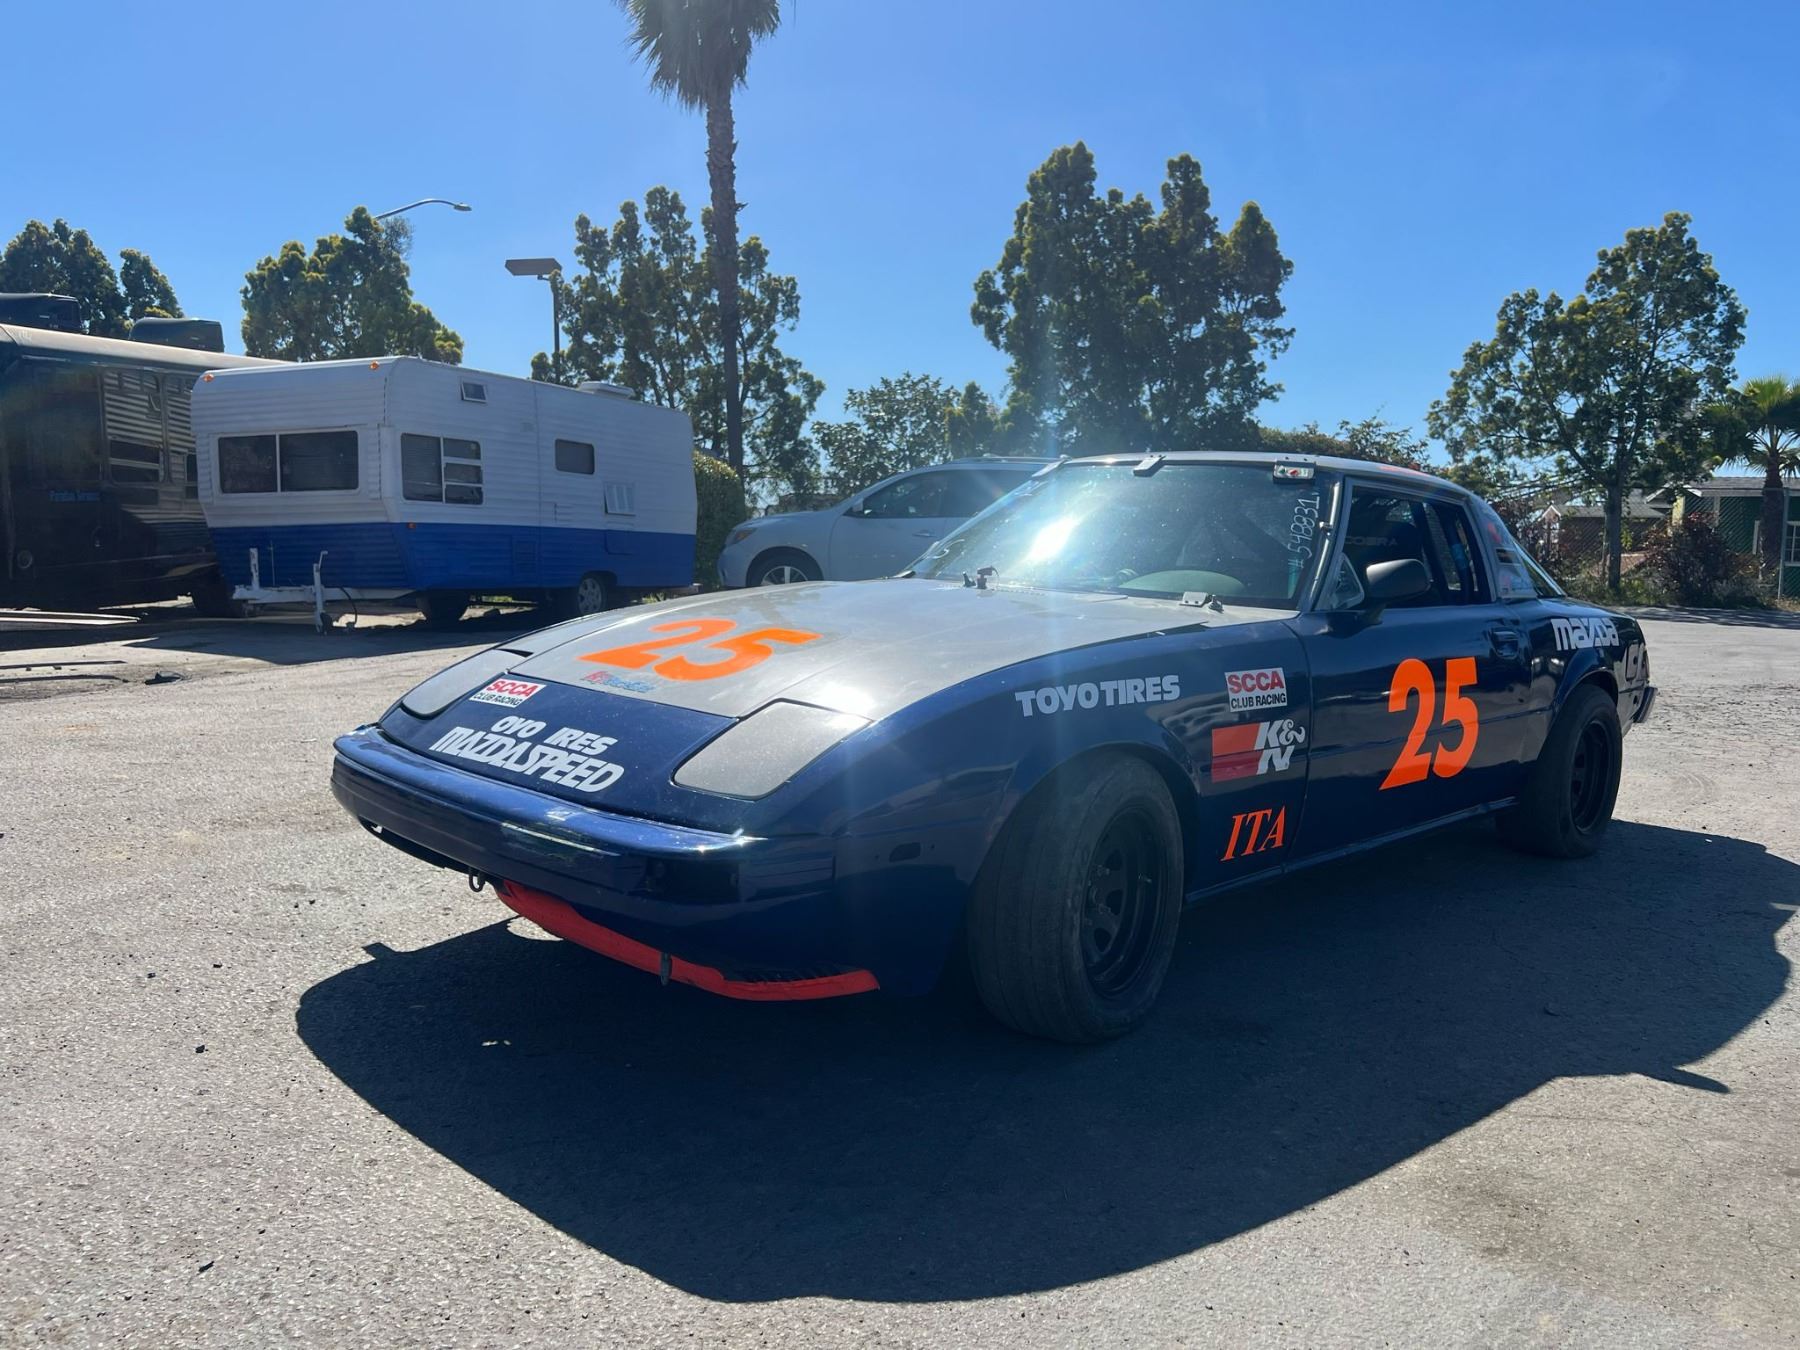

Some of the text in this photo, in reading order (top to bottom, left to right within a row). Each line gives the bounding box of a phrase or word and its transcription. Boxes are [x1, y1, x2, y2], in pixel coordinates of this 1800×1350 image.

[576, 617, 823, 682] 25
[473, 691, 524, 707] CLUB RACING
[486, 680, 539, 698] SCCA
[1015, 675, 1181, 718] TOYO TIRES
[1227, 670, 1285, 695] SCCA
[1230, 692, 1287, 710] CLUB RACING
[490, 715, 619, 756] OYO IRES
[1378, 656, 1479, 791] 25
[428, 726, 625, 793] MAZDASPEED
[1220, 805, 1286, 862] ITA
